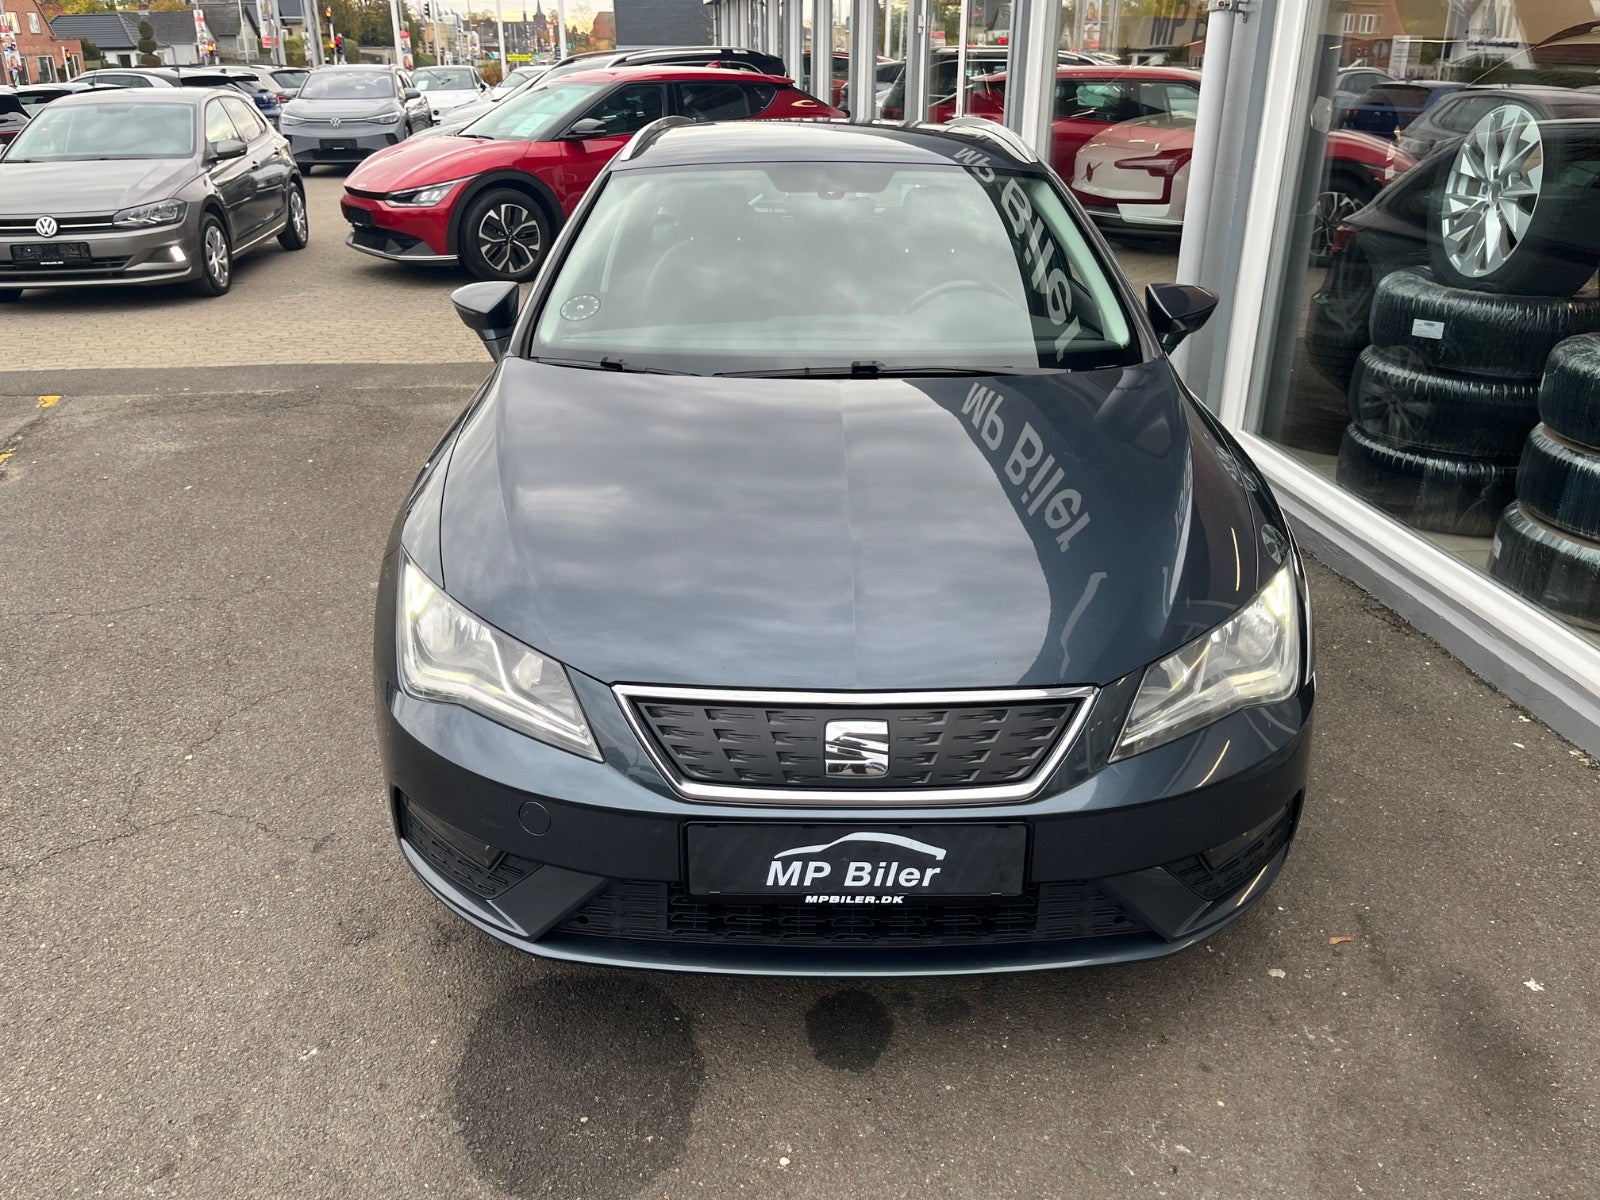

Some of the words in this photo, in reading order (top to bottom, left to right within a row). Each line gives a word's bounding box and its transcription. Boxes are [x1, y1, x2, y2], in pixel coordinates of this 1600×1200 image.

[766, 861, 831, 886] MP
[844, 861, 941, 887] Biler
[805, 895, 904, 904] MPBILER.DK
